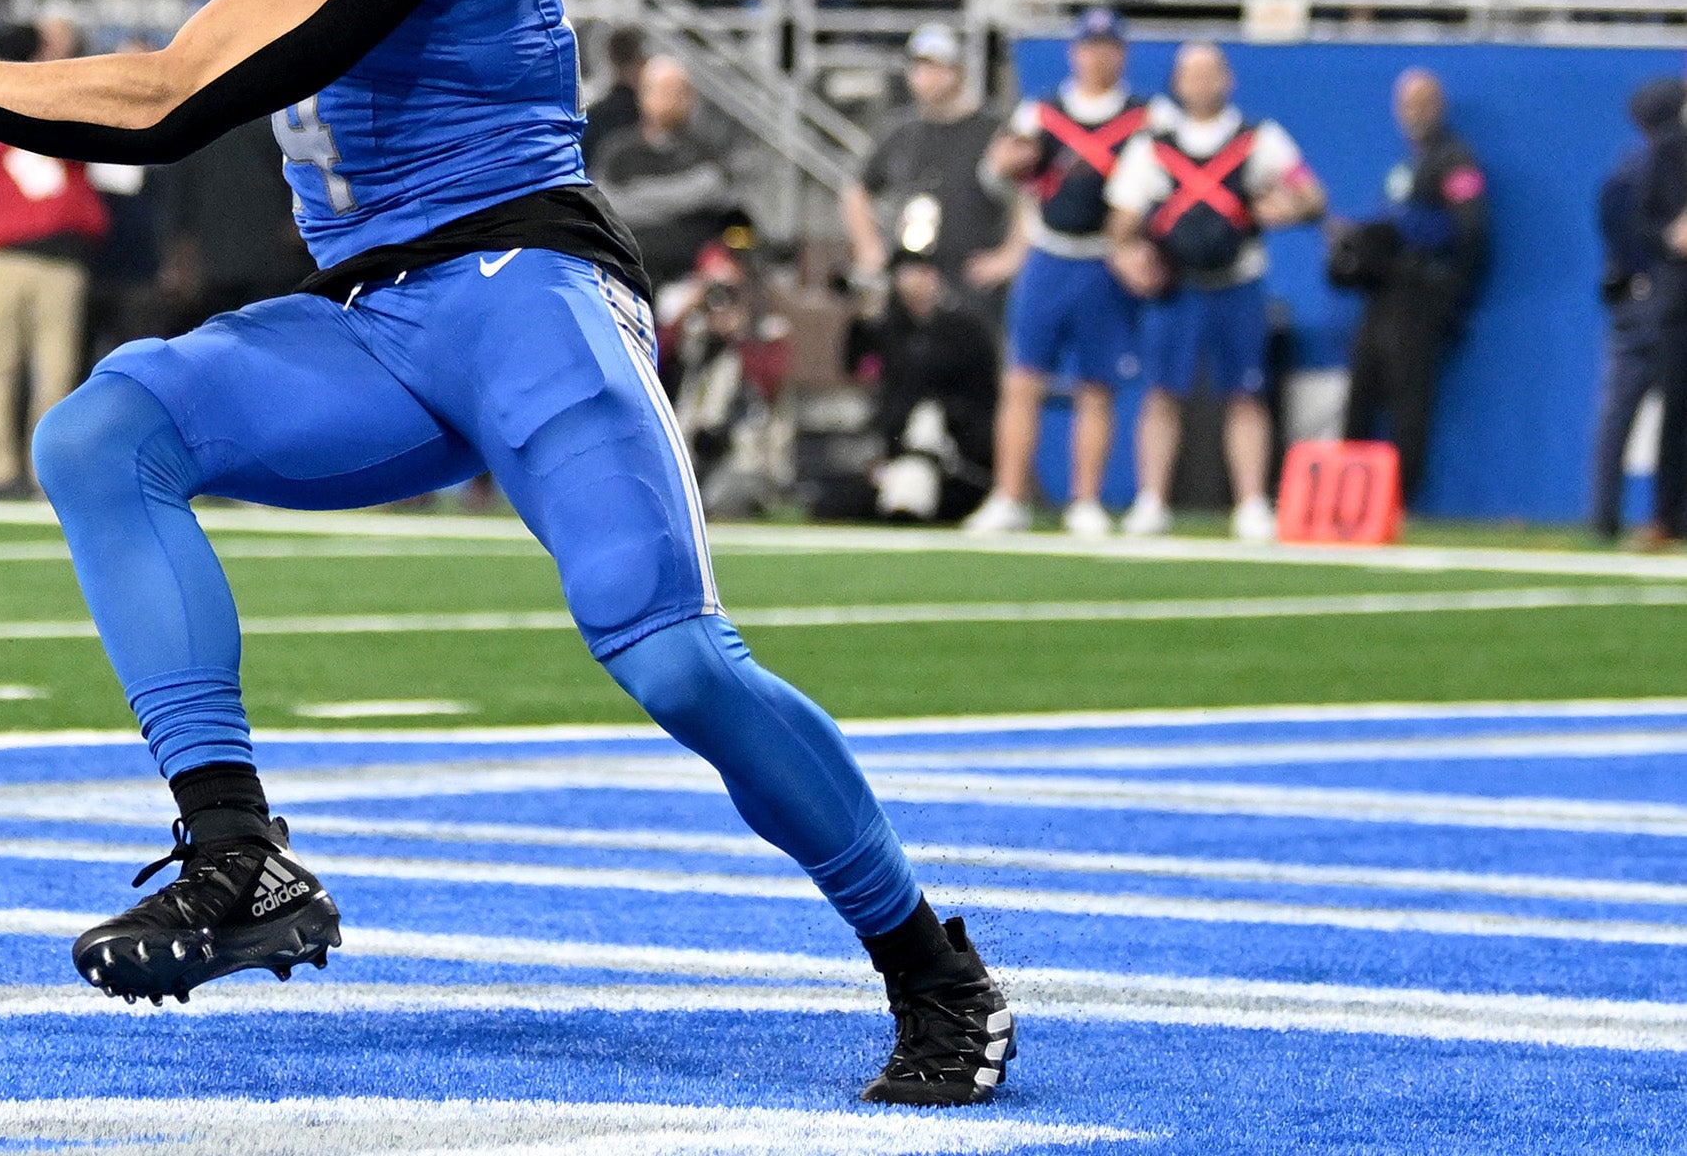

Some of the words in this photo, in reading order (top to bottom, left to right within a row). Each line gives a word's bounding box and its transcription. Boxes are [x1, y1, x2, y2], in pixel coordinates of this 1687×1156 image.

[271, 93, 359, 218] 4
[1304, 459, 1374, 538] 10
[251, 881, 311, 918] adidas
